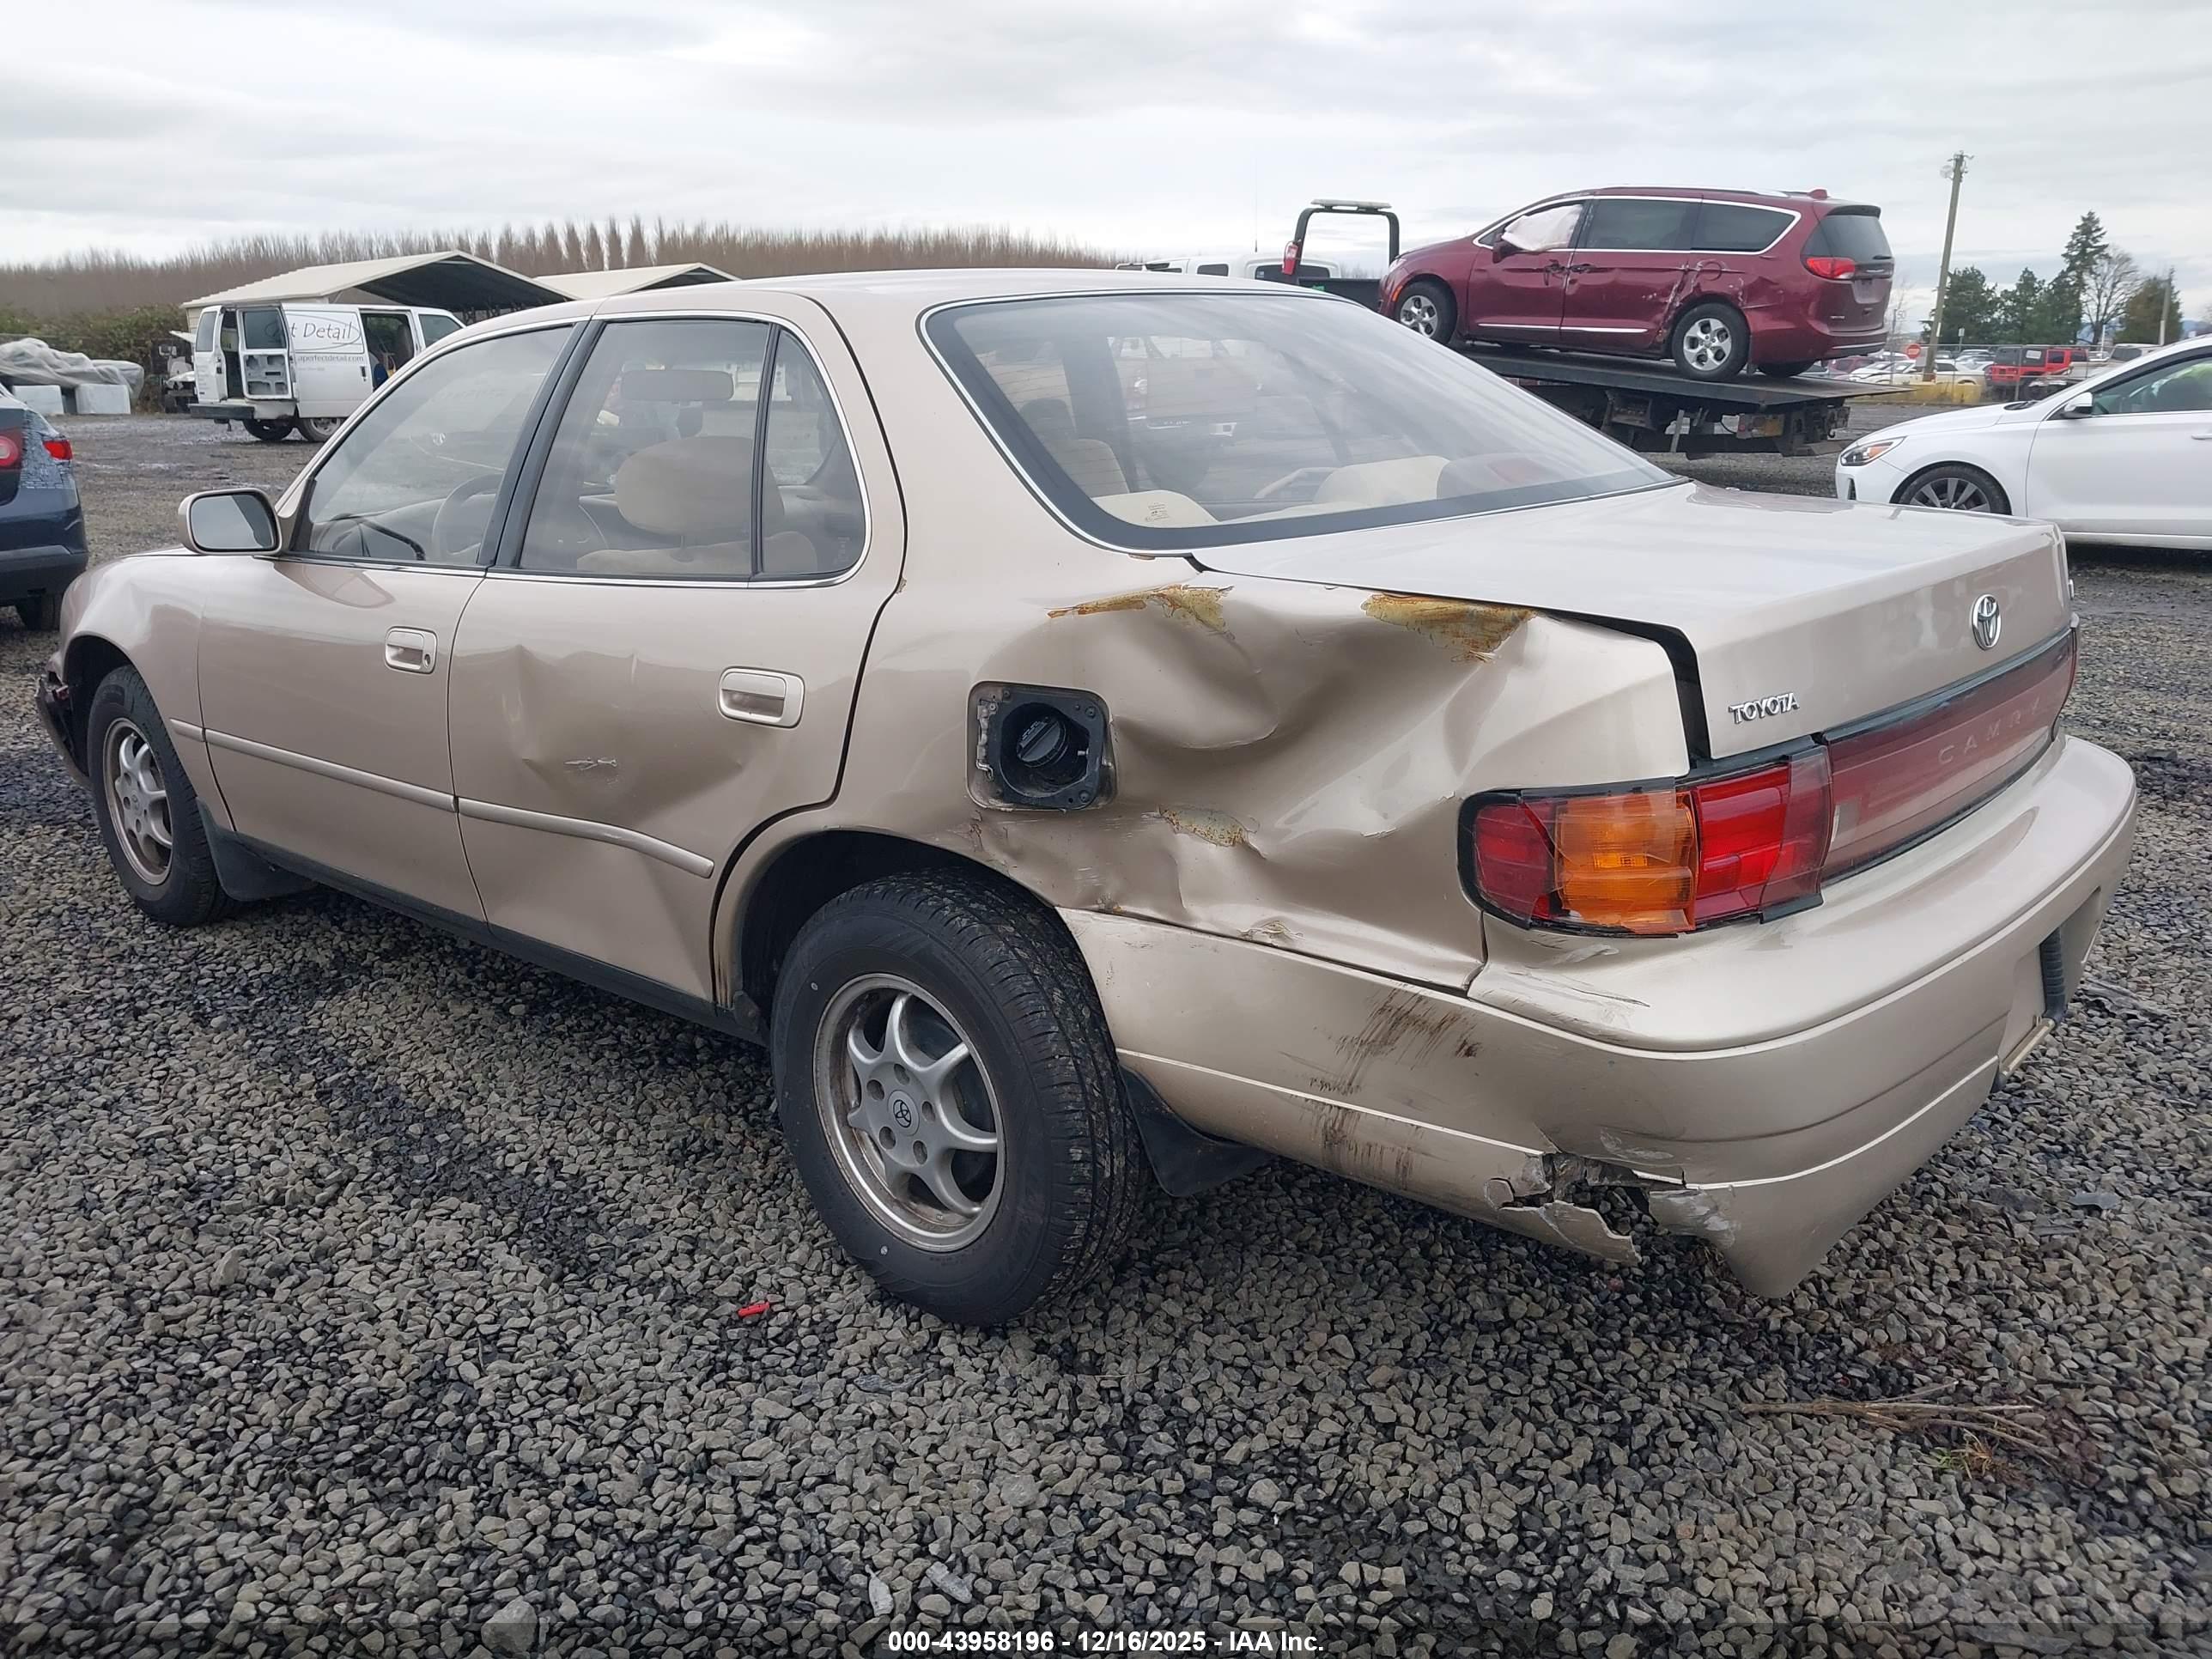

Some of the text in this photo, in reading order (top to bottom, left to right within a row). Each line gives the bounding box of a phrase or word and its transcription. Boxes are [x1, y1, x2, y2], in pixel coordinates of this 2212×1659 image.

[303, 321, 353, 341] Detail
[1728, 692, 1800, 724] TOYOTA
[1938, 695, 2040, 765] CAMRY
